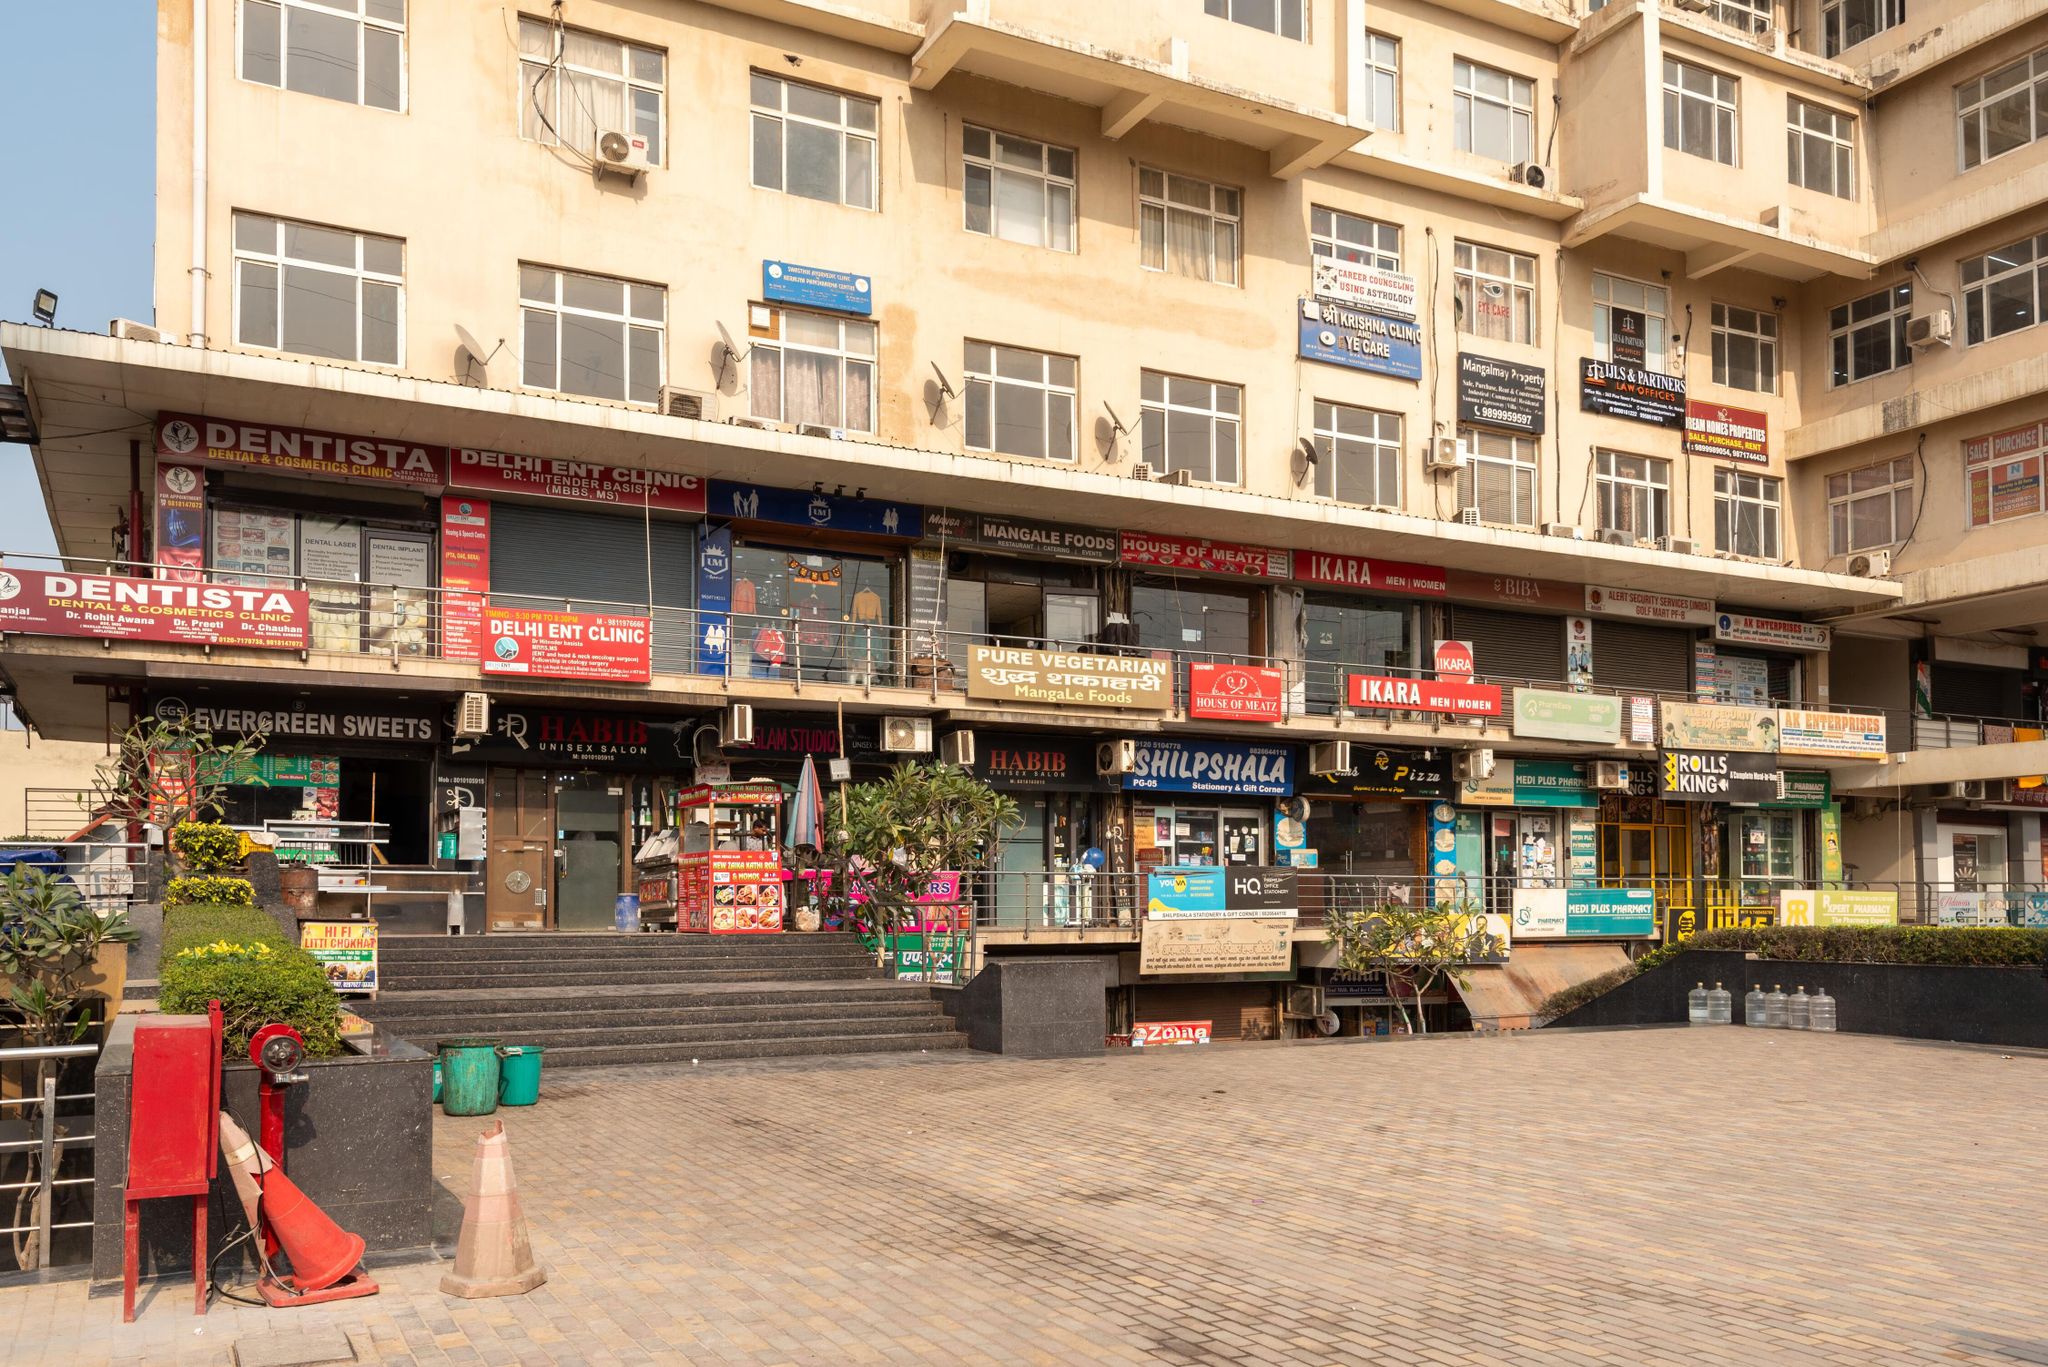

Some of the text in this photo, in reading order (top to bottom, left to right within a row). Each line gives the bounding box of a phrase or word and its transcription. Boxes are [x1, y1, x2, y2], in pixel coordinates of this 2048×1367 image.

[1339, 269, 1367, 282] CAREER
[1370, 275, 1414, 292] COUNSELING
[1340, 282, 1364, 295] USING
[1367, 288, 1413, 304] ASTROLOGY
[1478, 301, 1510, 318] EYE CARE
[1341, 312, 1421, 345] KRISHNA CLINIC
[1358, 330, 1371, 339] AND
[1338, 336, 1390, 358] EYE CARE
[1463, 359, 1509, 381] Mangalmay
[1606, 364, 1685, 393] IJLS & PARTNERS
[1616, 382, 1675, 401] LAW OFFICES
[1482, 407, 1531, 424] 9899959597
[1706, 420, 1765, 442] HOMES PROPERTIES
[206, 422, 434, 473] DENTISTA
[1689, 432, 1761, 451] SALE, PURCHASE, RENT
[1969, 429, 2037, 460] SALE PURCHASE
[209, 448, 392, 479] DENTAL & COSMETICS CLINIC
[461, 449, 698, 490] DELHI ENT CLINIC
[504, 469, 660, 496] DR. HITENDER BASISTA
[597, 489, 619, 502] MS)
[306, 538, 356, 548] DENTAL LASER
[984, 524, 1060, 545] MANGALE
[1065, 533, 1115, 550] FOODS
[998, 540, 1033, 550] RESTAURANT
[1043, 545, 1069, 553] CATERING
[1123, 539, 1181, 555] HOUSE
[1186, 546, 1207, 558] OF
[1213, 549, 1264, 565] MEATZ
[1312, 555, 1445, 591] IKARA MEN WOMEN
[44, 576, 294, 614] DENTISTA
[1505, 578, 1541, 598] BIBA
[1609, 591, 1628, 601] ALERT
[1630, 593, 1658, 604] SECURITY
[1661, 597, 1688, 609] SERVICES
[48, 598, 292, 622] DENTAL & COSMETICS CLINIC
[66, 610, 154, 625] Dr. Rohit Awana
[485, 610, 509, 618] TIMING
[1636, 606, 1669, 618] GOLF MART
[173, 618, 223, 629] Dr. Preeti
[241, 622, 302, 634] Dr. Chauhan
[491, 620, 644, 644] DELHI ENT CLINIC
[1744, 618, 1801, 634] AK ENTERPRISES
[978, 648, 1166, 675] PURE VEGETARIAN
[981, 667, 1039, 685] शुद्ध
[1089, 690, 1132, 704] Foods
[1197, 697, 1277, 711] HOUSE OF MEATZ
[1361, 680, 1491, 711] IKARA MEN WOMEN
[158, 705, 185, 717] EGS
[1716, 710, 1757, 722] SECURITY
[194, 708, 432, 739] EVERGREEN SWEETS
[541, 715, 648, 745] HABIB
[1785, 711, 1879, 733] AK ENTERPRISES
[540, 743, 647, 754] UNISEX SALON
[989, 750, 1066, 771] HABIB
[1135, 749, 1286, 783] SHILPSHALA
[1679, 754, 1727, 775] ROLLS
[1133, 779, 1157, 787] PG-05
[1394, 766, 1440, 781] Pizza
[1516, 776, 1556, 785] MEDI PLUS
[1192, 782, 1233, 793] Stationery
[1243, 784, 1257, 793] Gift
[1259, 785, 1284, 793] Corner
[1680, 774, 1717, 793] KING
[1794, 783, 1824, 791] PHARMACY
[1569, 904, 1651, 913] MEDI PLUS PHARMACY
[1854, 904, 1891, 913] PHARMACY
[325, 926, 351, 937] HI FI
[305, 938, 370, 948] LITTI CHOKHA
